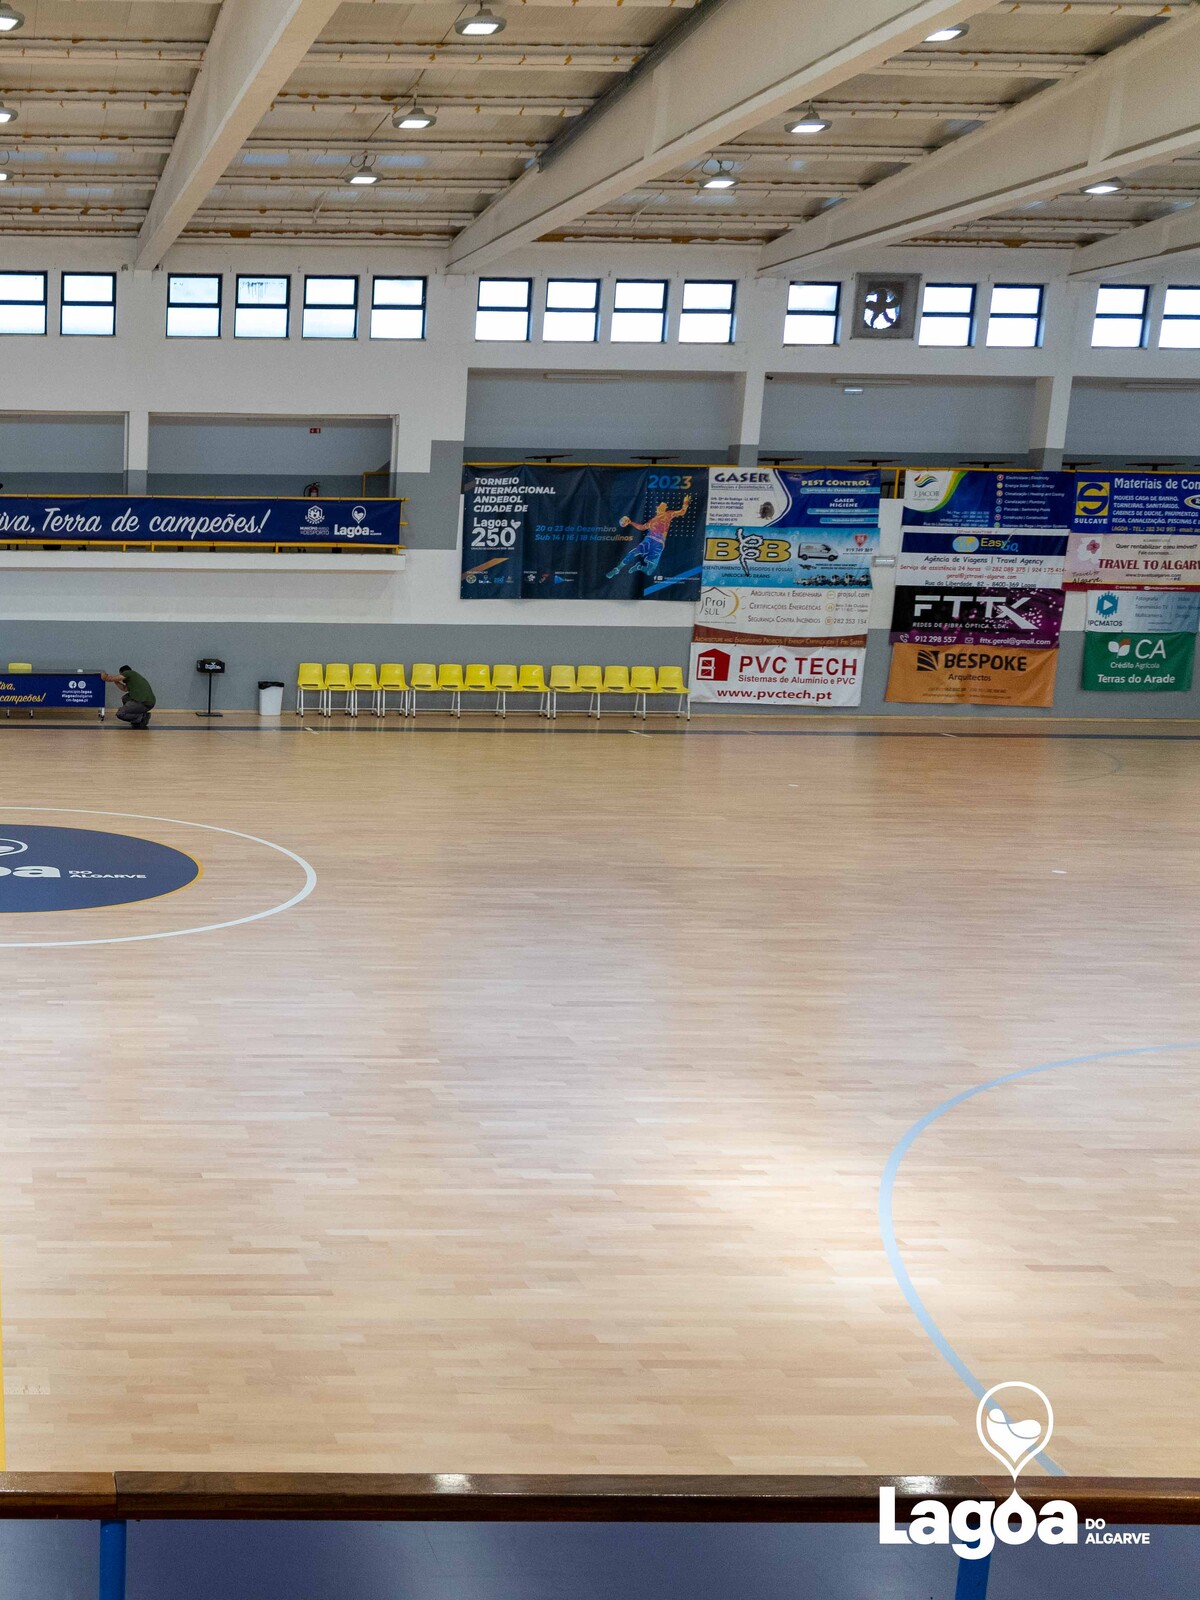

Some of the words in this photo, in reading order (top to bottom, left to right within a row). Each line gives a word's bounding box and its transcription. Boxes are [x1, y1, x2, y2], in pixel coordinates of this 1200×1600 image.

[475, 477, 519, 485] TORNEIO
[648, 475, 692, 489] 2023
[715, 473, 770, 482] GASER
[1114, 478, 1162, 488] Materiais
[1165, 478, 1178, 489] de
[42, 507, 102, 532] Terra
[111, 508, 140, 532] de
[149, 509, 272, 540] campeões!
[474, 517, 508, 529] Lagoa
[334, 524, 370, 538] Lagoa
[471, 527, 516, 546] 250
[981, 538, 1008, 548] Easy
[1099, 559, 1139, 569] TRAVEL
[1144, 560, 1158, 570] TO
[705, 597, 725, 608] Proj
[1135, 639, 1166, 659] CA
[739, 656, 787, 674] PVC
[795, 658, 857, 676] TECH
[944, 652, 1026, 672] BESPOKE
[738, 675, 777, 683] Sistemas
[948, 673, 991, 682] Arquitectos
[1098, 674, 1125, 683] Terras
[1128, 674, 1141, 683] do
[1144, 674, 1175, 683] Arade
[0, 692, 46, 704] campeões!
[717, 690, 832, 701] www.pvctech.pt
